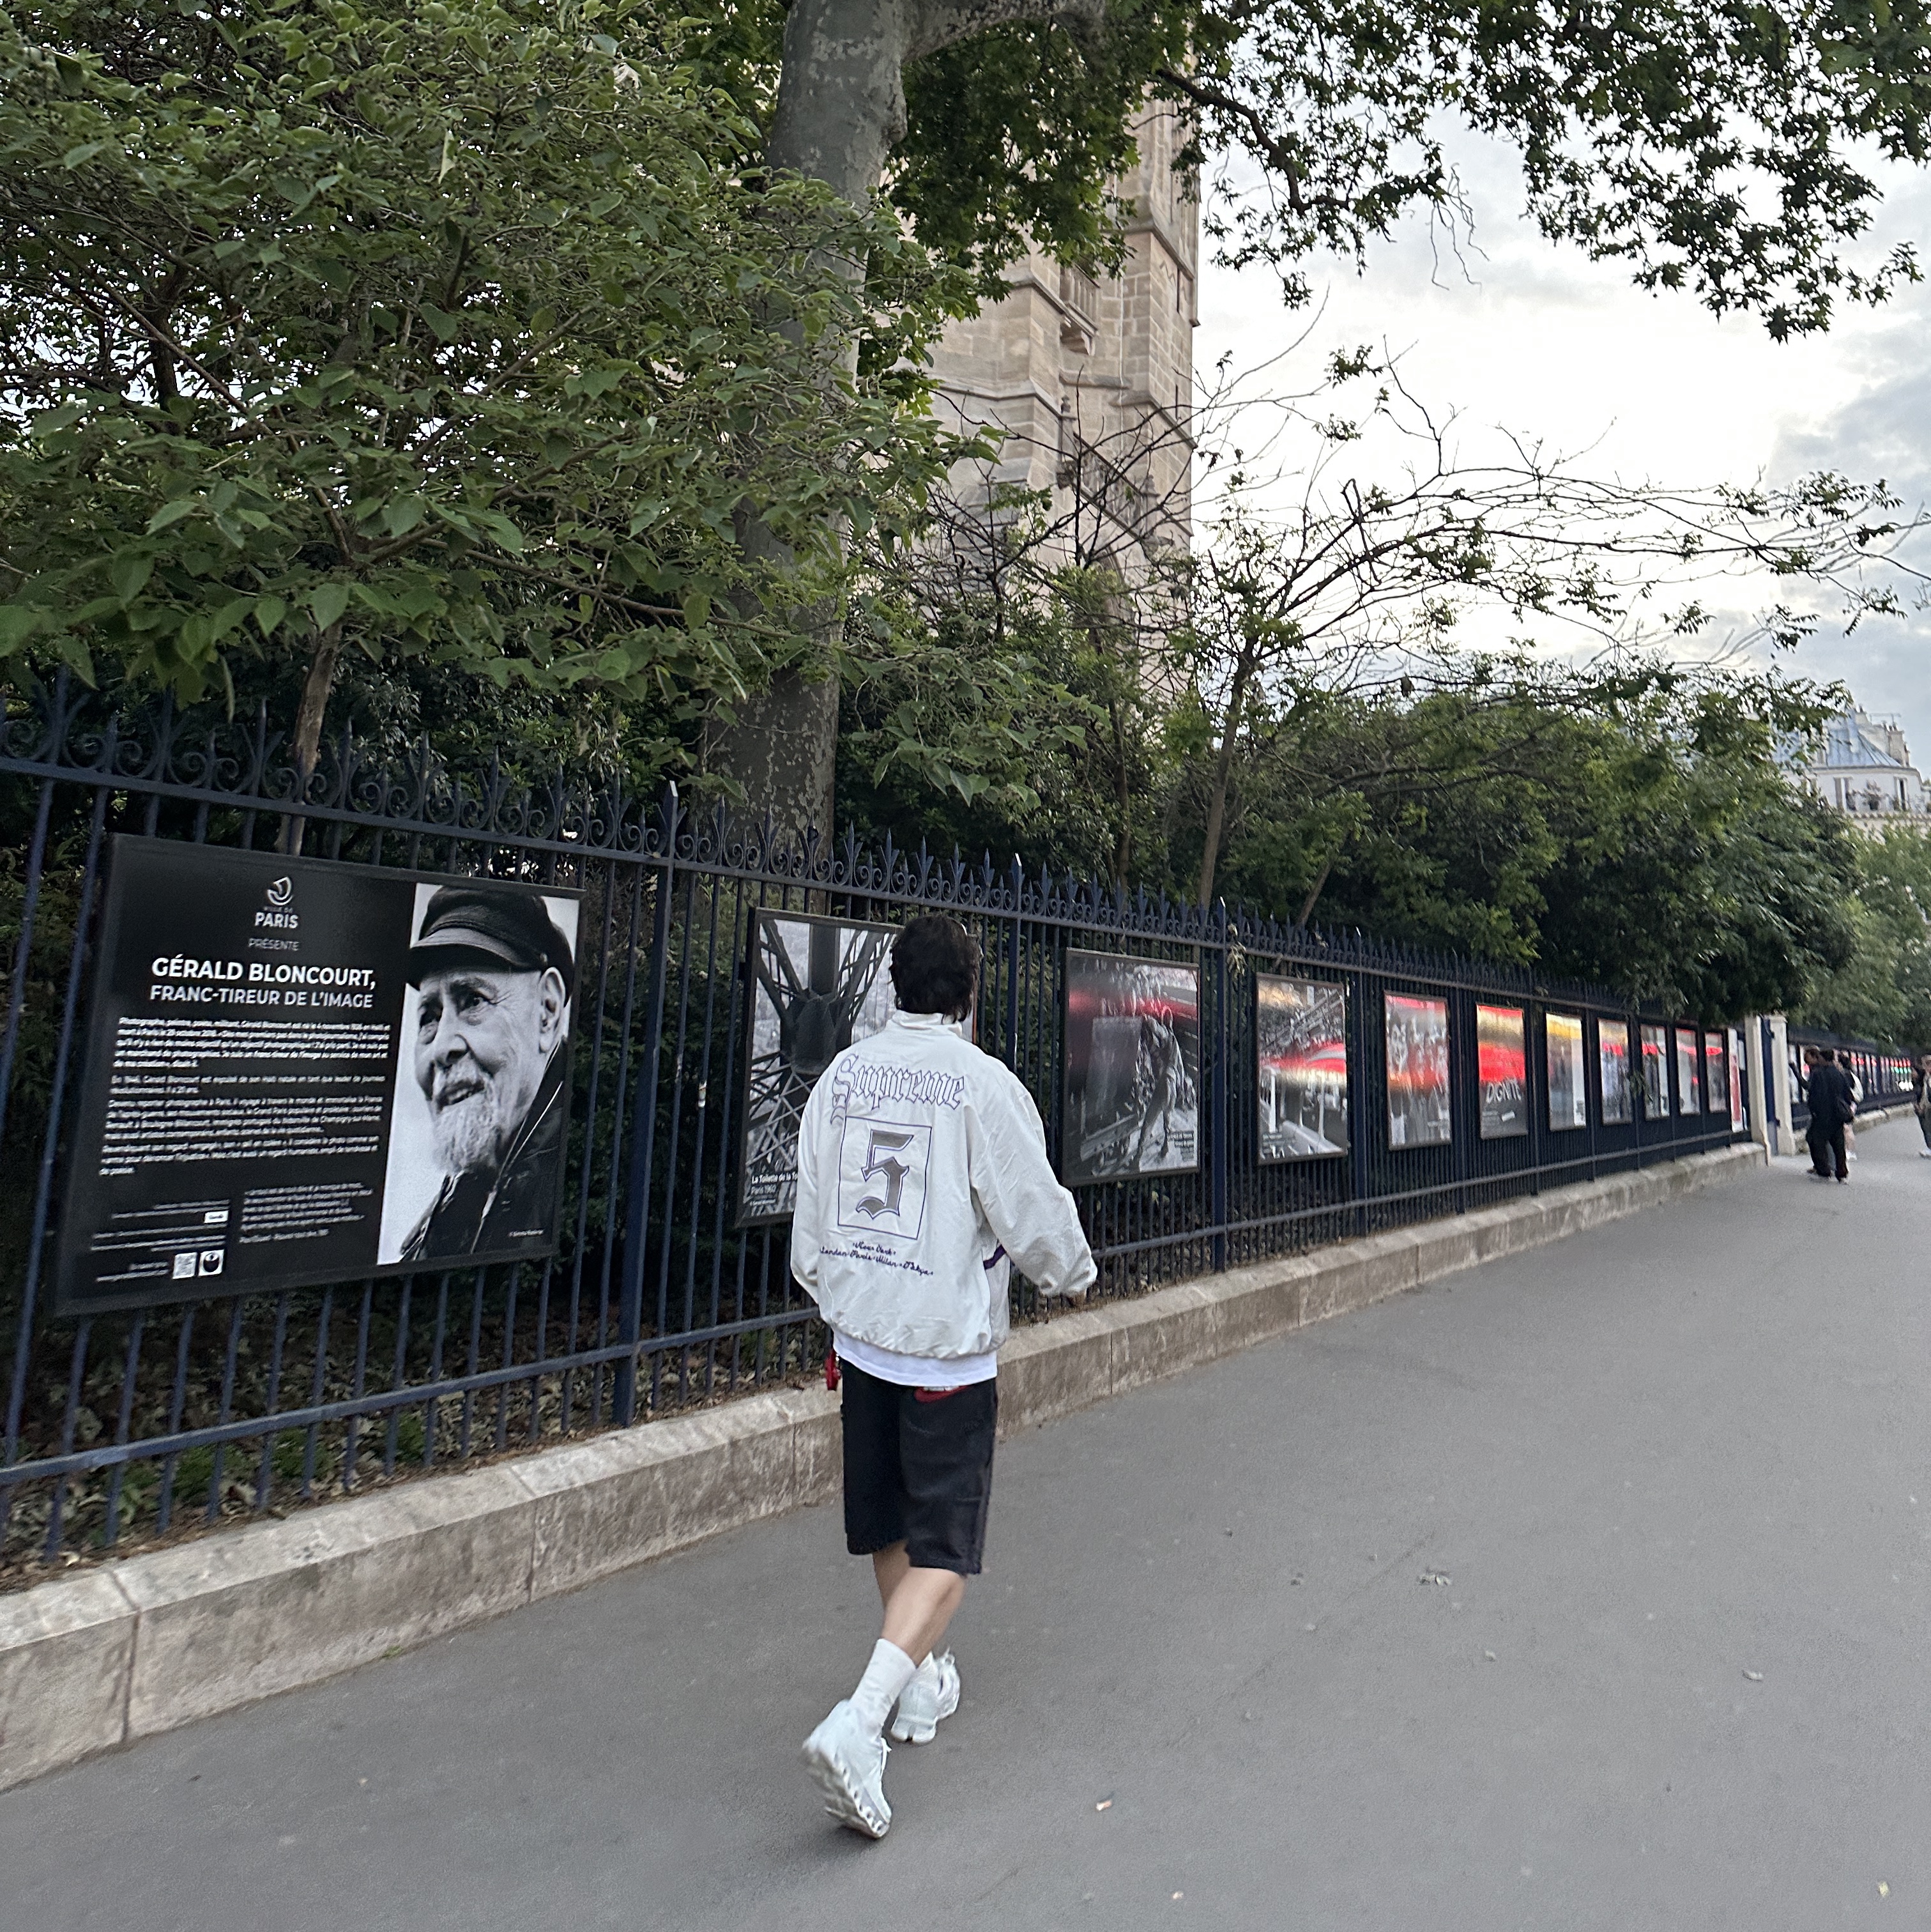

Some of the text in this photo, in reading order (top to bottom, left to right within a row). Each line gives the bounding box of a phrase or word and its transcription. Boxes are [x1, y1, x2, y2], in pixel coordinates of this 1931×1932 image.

[255, 912, 298, 928] PARIS
[248, 937, 300, 951] PRÉSENTE
[151, 954, 376, 990] GÉRALD BLONCOURT,
[150, 985, 374, 1008] FRANC-TIREUR DE L'IMAGE
[830, 1052, 965, 1125] Supreme
[856, 1128, 915, 1220] 5
[876, 1255, 898, 1268] Milan
